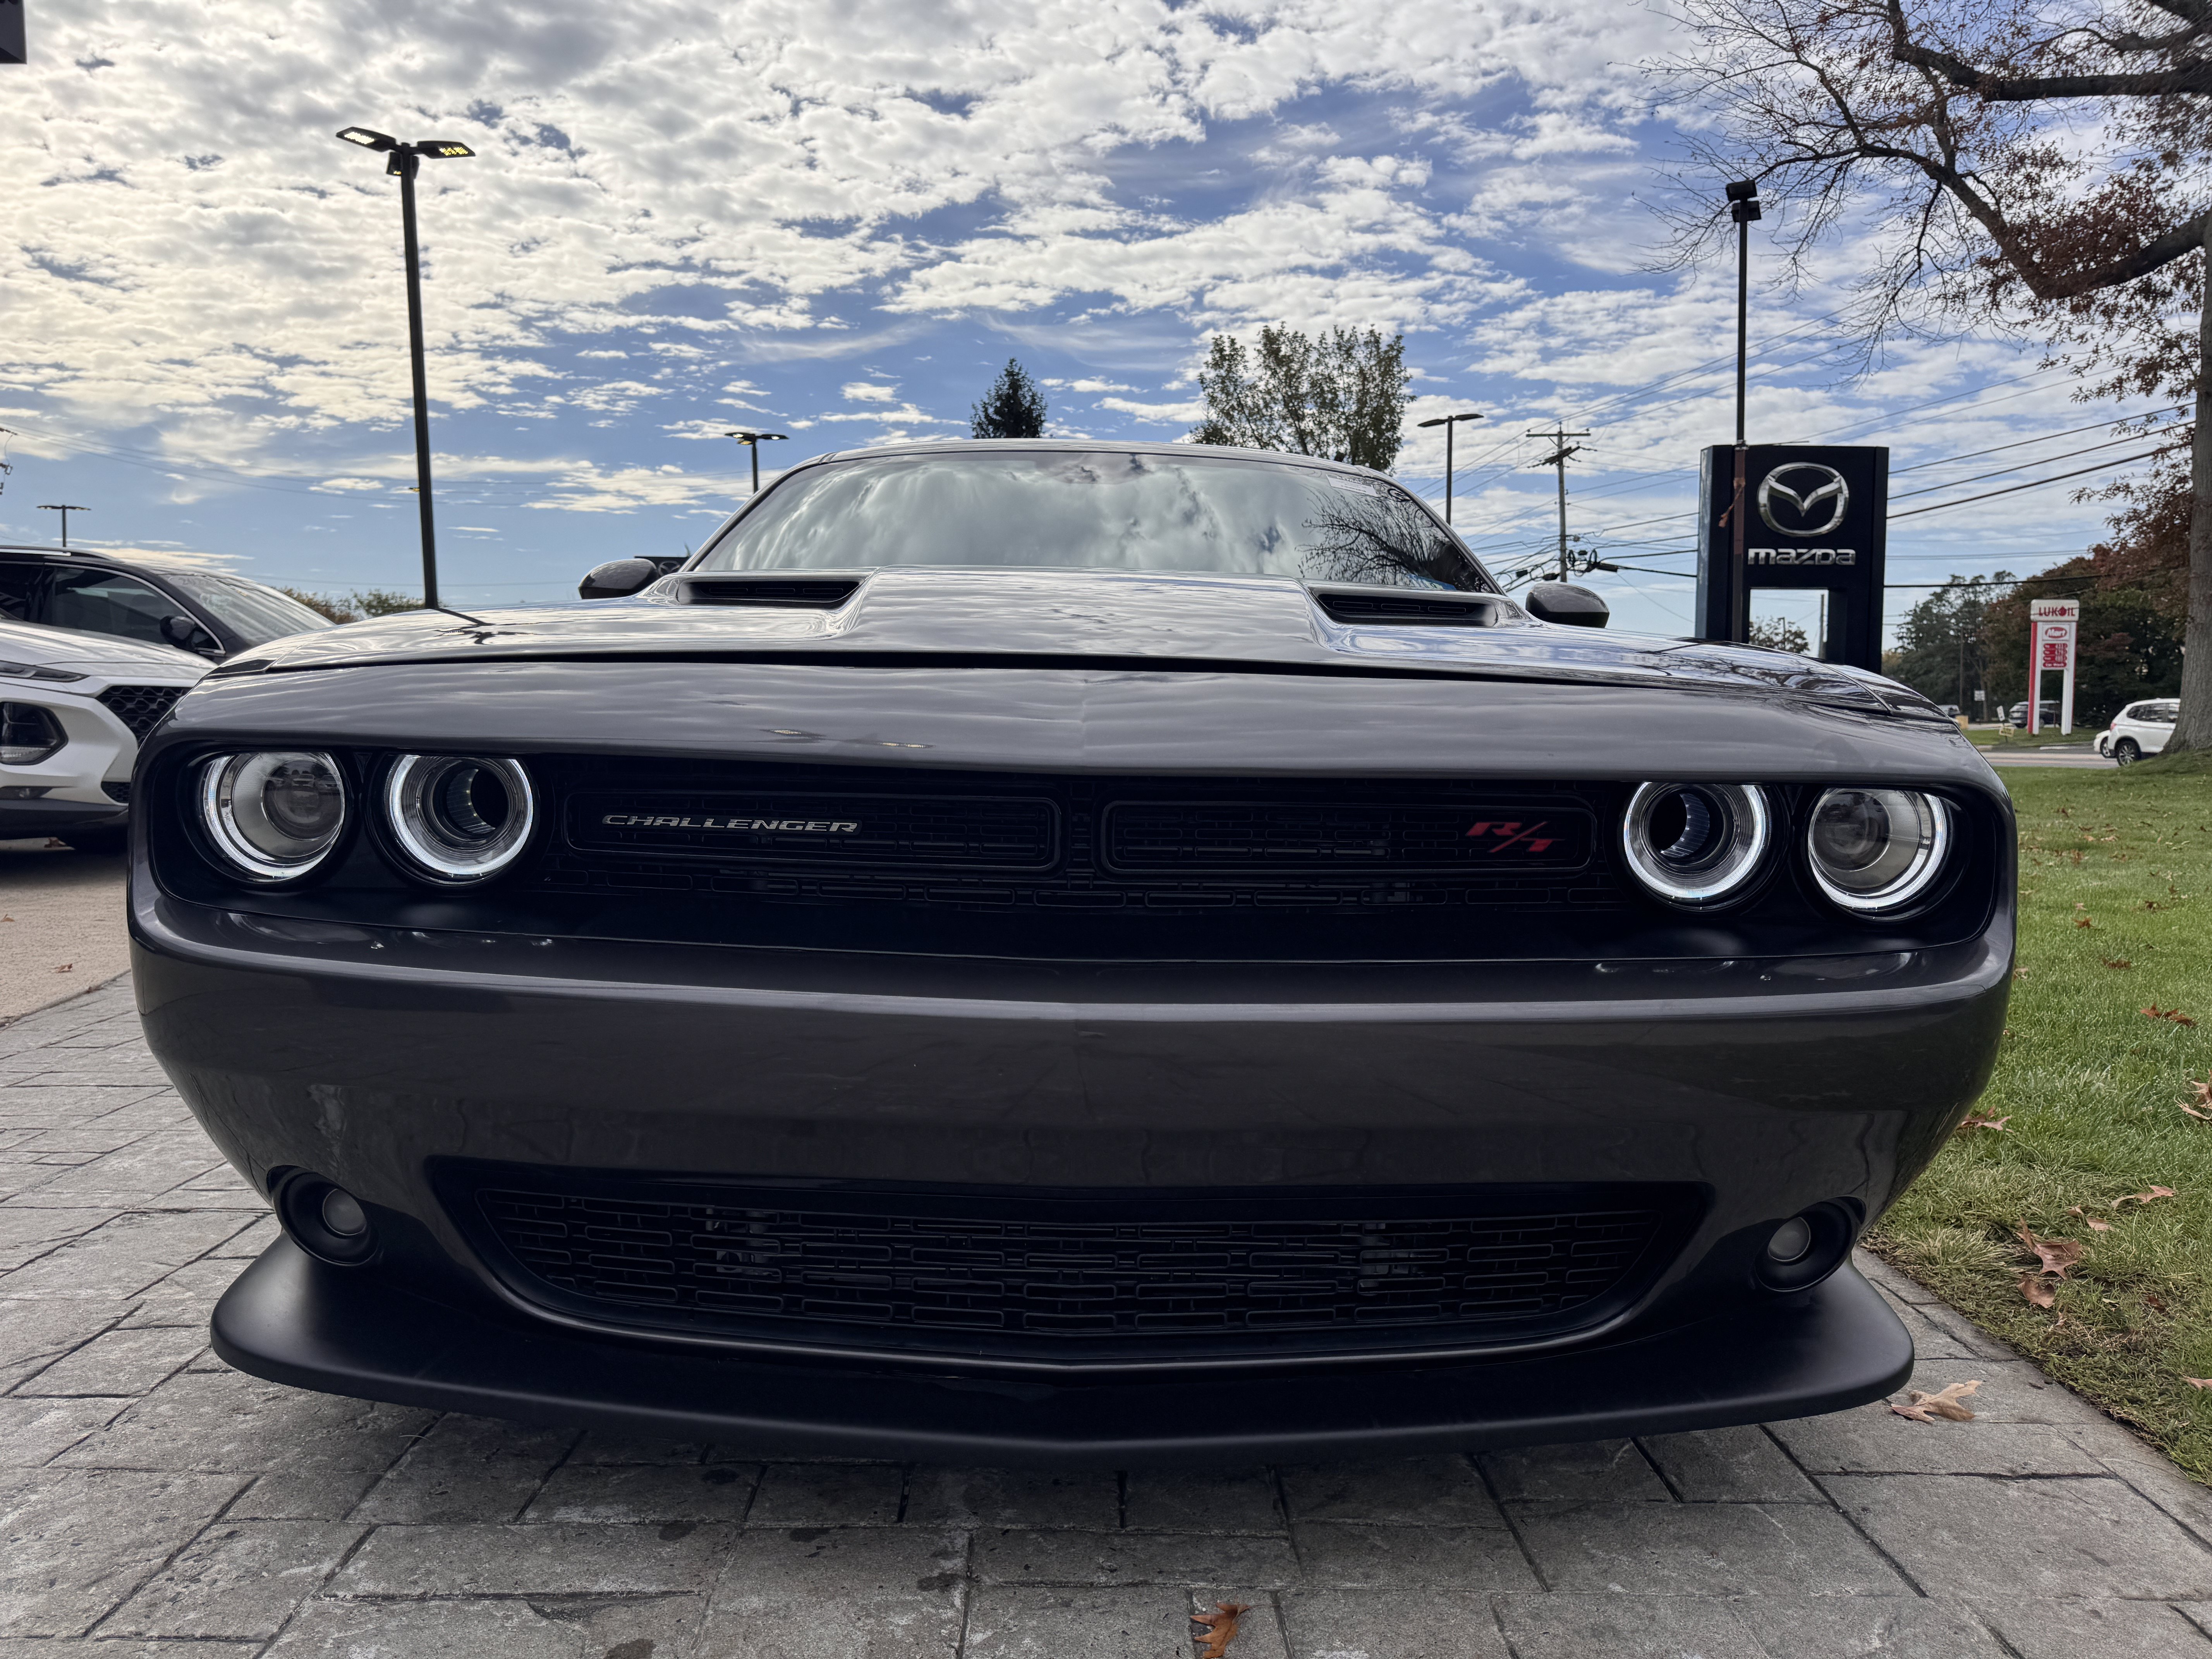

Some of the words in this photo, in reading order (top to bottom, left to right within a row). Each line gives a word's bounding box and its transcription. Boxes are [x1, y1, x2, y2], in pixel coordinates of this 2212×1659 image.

[1747, 548, 1856, 565] mazda
[2039, 605, 2075, 617] LUKOIL
[2047, 628, 2066, 637] Mart
[602, 815, 857, 832] CHALLENGER
[1465, 821, 1565, 853] R/T
